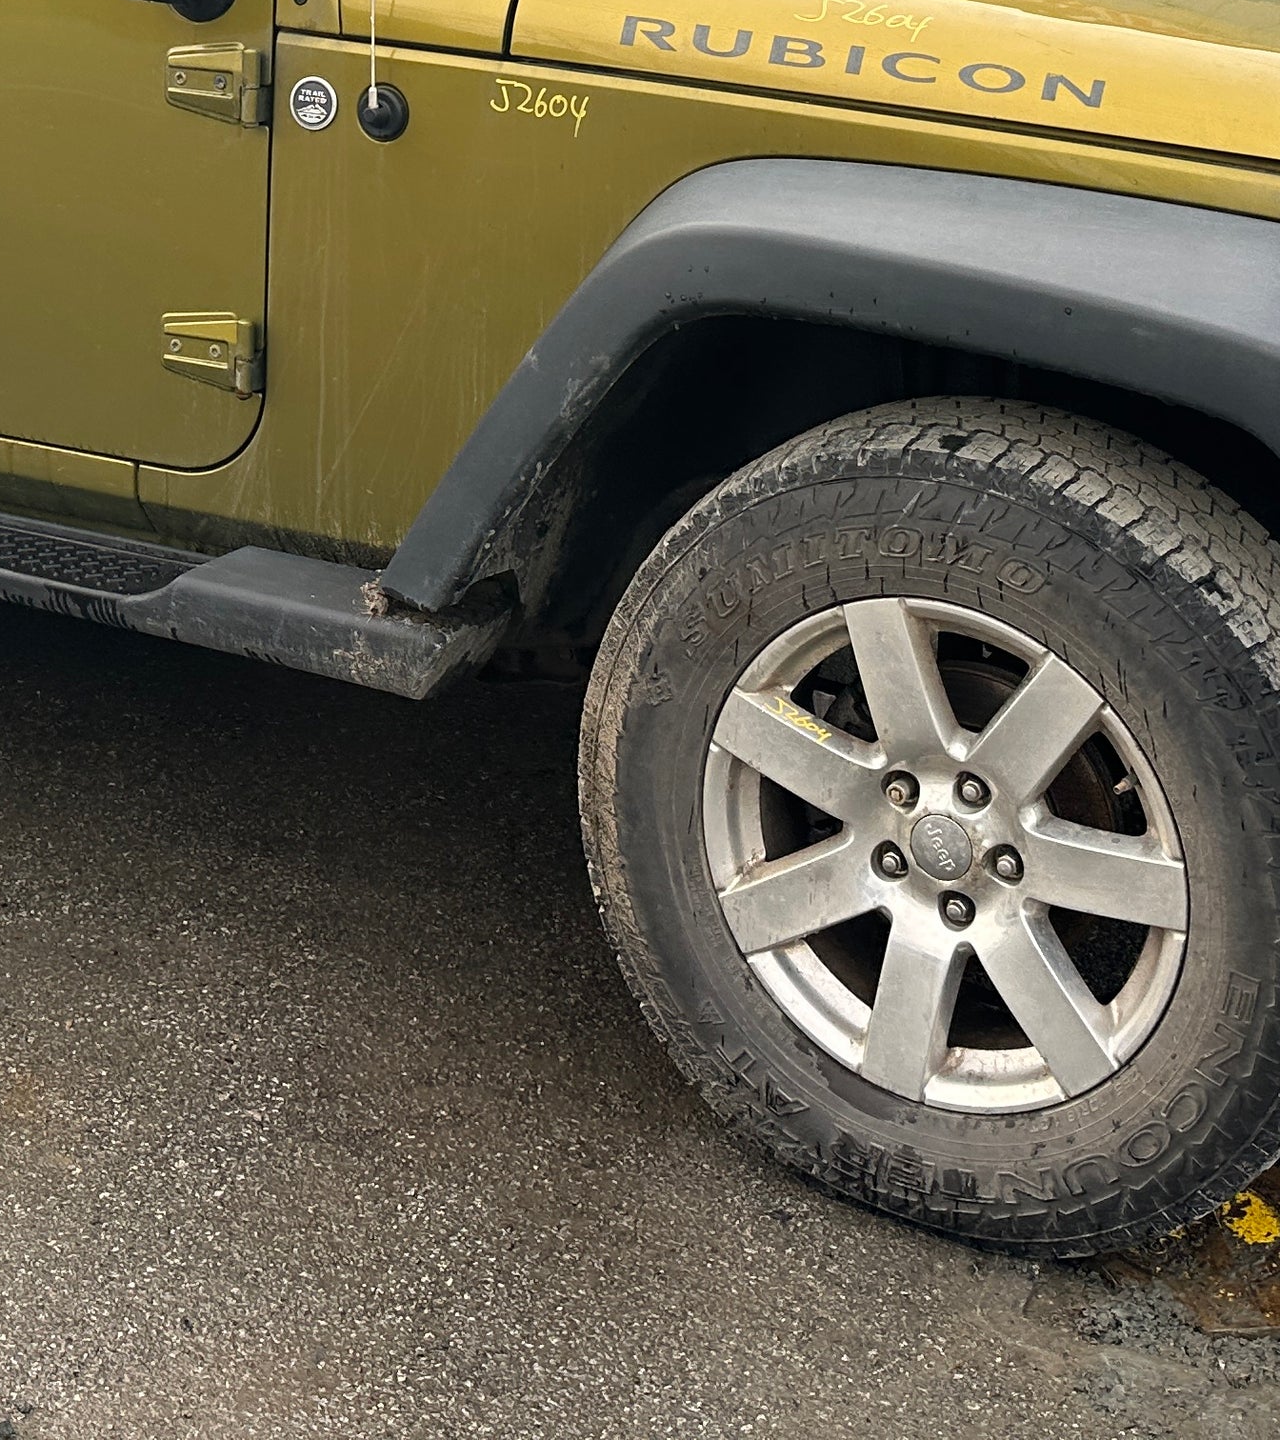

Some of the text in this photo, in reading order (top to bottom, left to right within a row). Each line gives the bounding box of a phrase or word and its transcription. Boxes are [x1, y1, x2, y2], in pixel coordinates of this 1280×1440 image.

[620, 15, 1106, 108] RUBICON
[298, 95, 328, 105] RATED
[300, 89, 327, 97] TRAIL
[490, 79, 590, 138] J2604
[924, 822, 957, 872] Jeep
